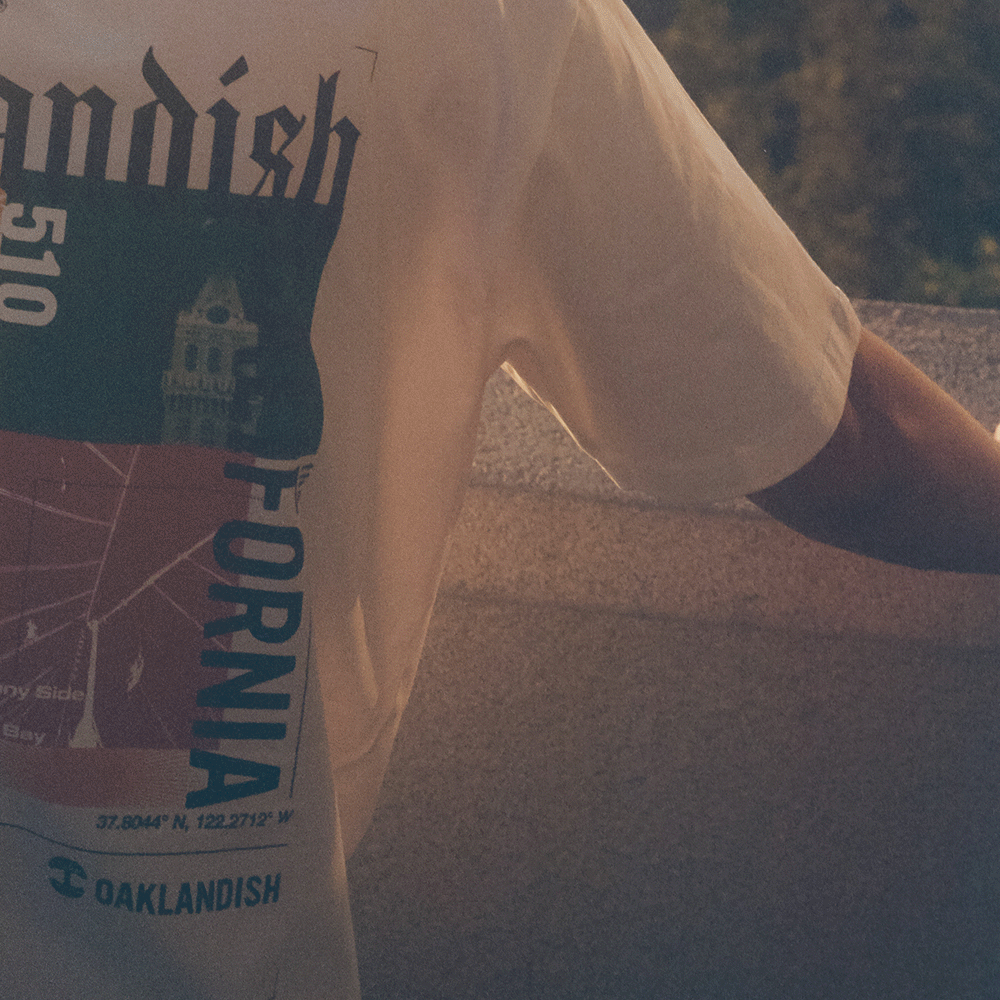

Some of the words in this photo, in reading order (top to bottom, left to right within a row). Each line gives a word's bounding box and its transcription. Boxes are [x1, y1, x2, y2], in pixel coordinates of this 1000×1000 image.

[34, 683, 86, 701] Side
[2, 722, 47, 748] Bay
[172, 814, 190, 832] N,
[278, 809, 295, 825] W
[94, 872, 282, 915] OAKLANDISH
